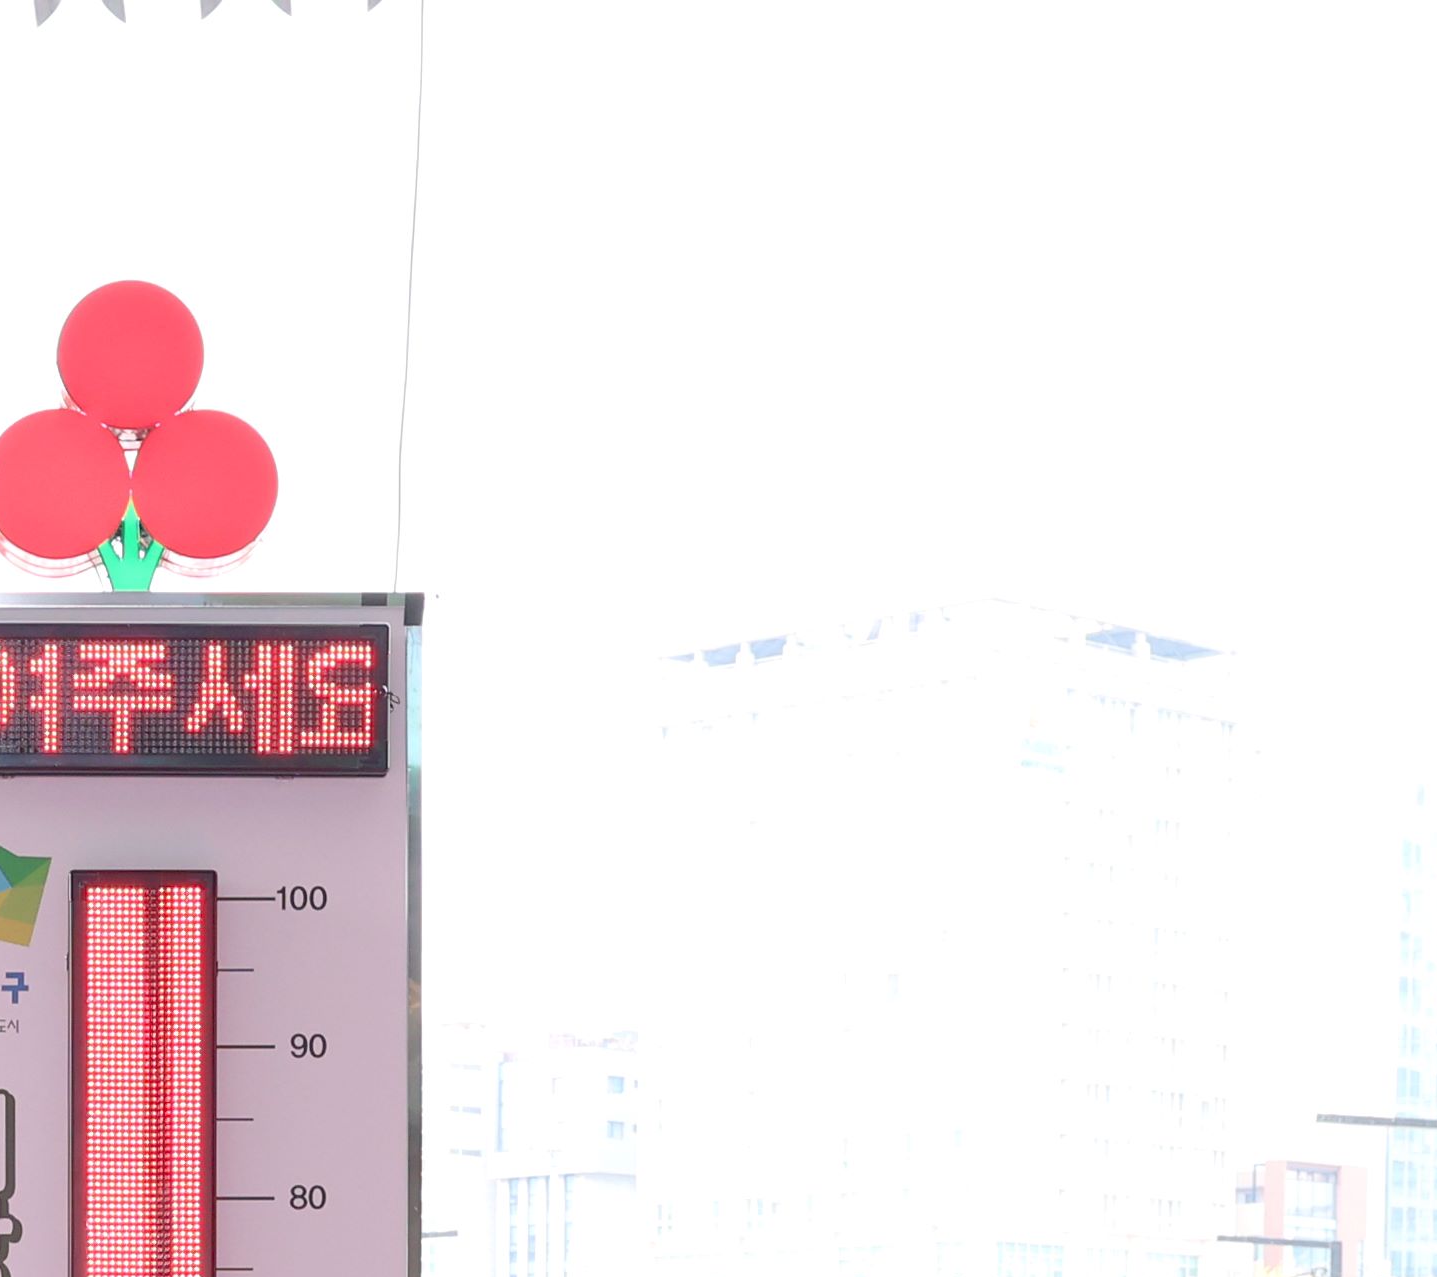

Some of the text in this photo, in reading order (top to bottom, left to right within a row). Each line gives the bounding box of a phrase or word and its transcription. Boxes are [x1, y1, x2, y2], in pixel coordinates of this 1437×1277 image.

[276, 887, 328, 911] 100
[290, 1034, 327, 1058] 90
[290, 1186, 327, 1210] 80
